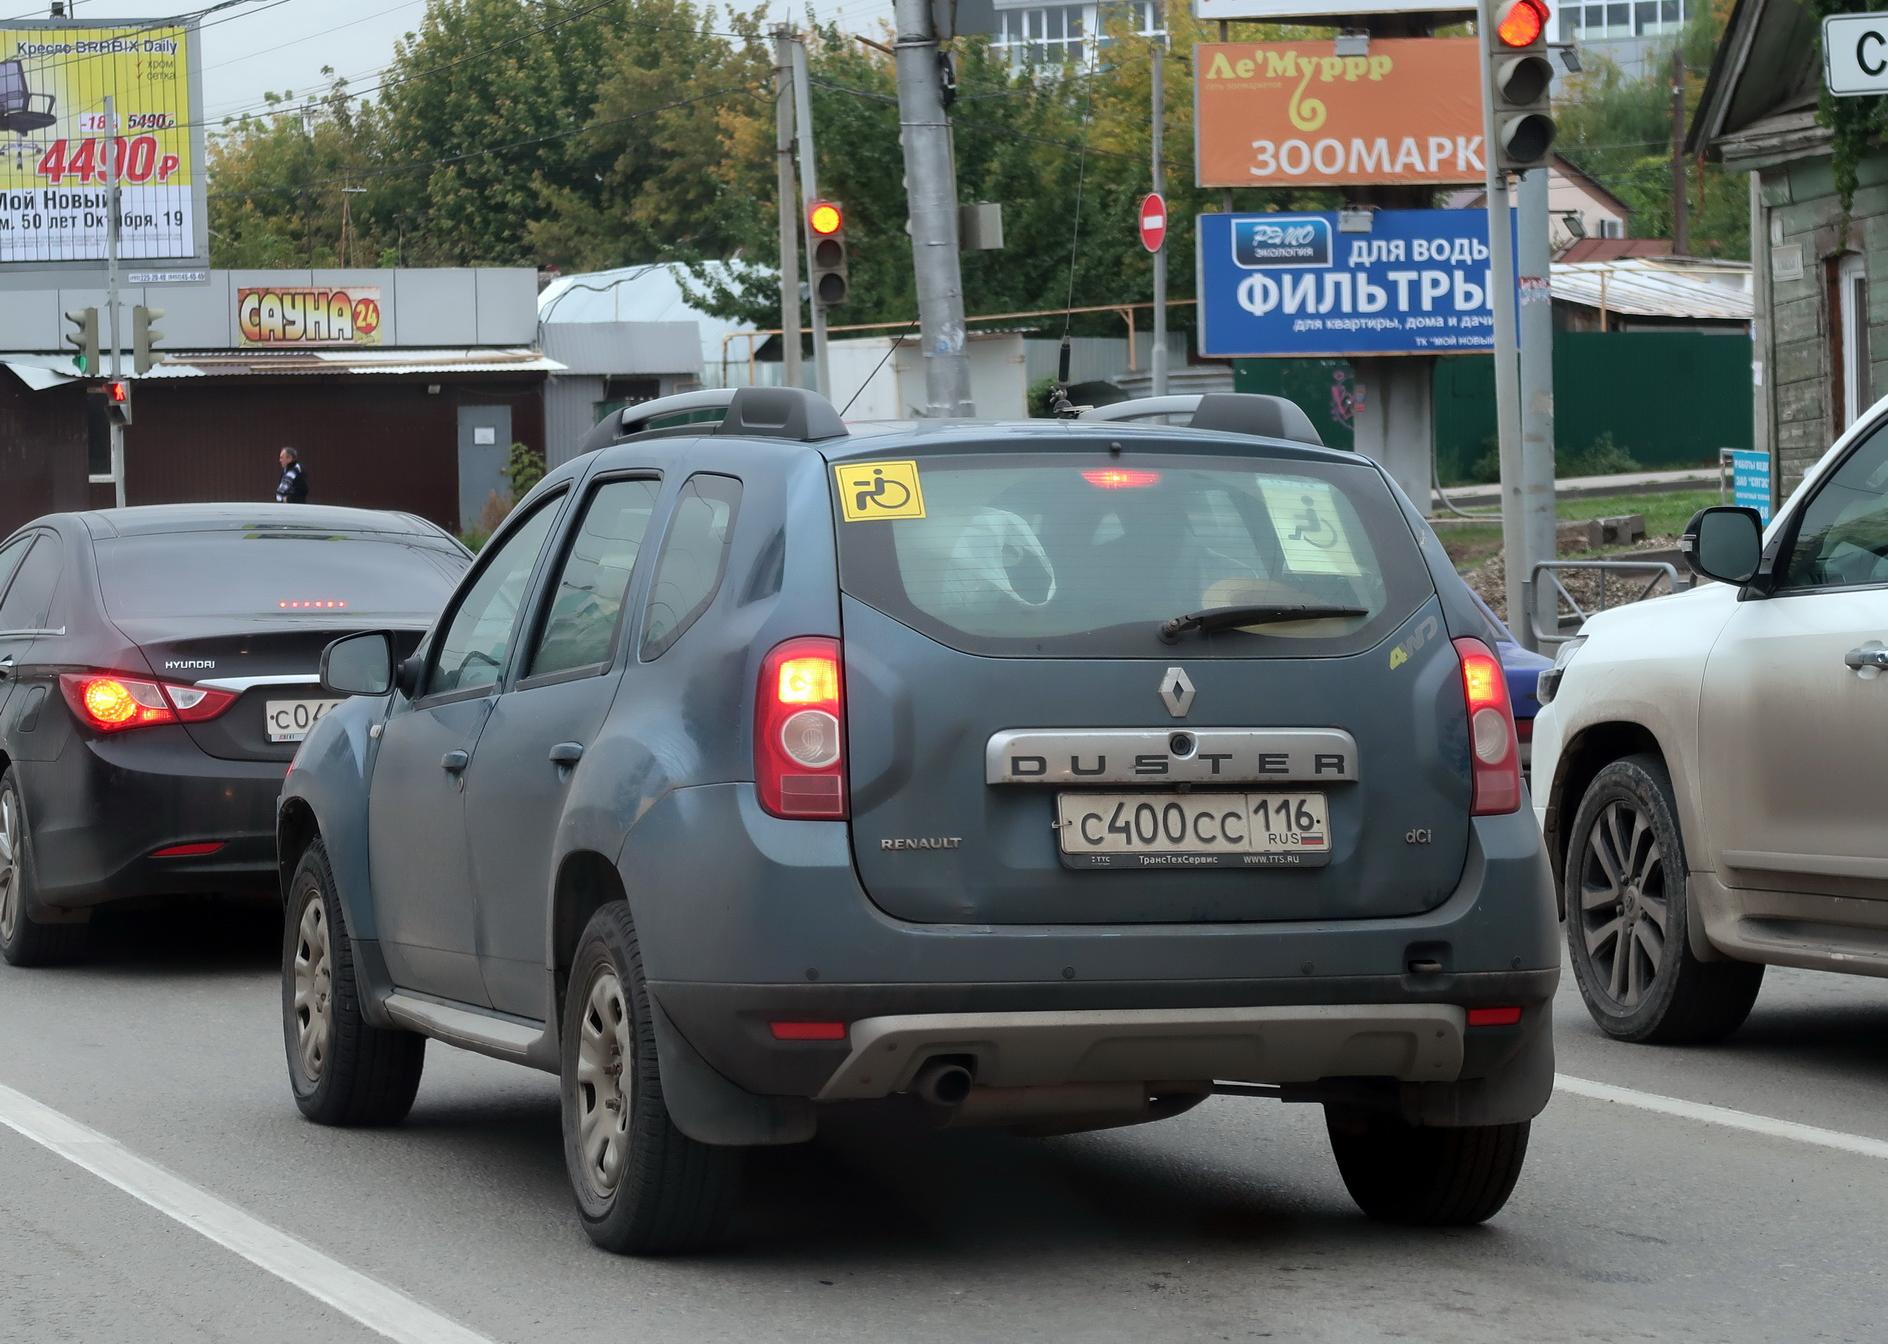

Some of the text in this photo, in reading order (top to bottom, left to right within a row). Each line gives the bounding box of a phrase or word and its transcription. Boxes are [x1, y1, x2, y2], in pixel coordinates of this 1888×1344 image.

[17, 42, 71, 56] Кресло
[144, 39, 177, 55] Daily
[21, 213, 42, 229] 50
[49, 216, 77, 229] лет
[163, 211, 183, 227] 19
[1254, 246, 1314, 258] ЭКОЛОГИЯ
[1348, 239, 1405, 267] ДЛЯ
[1237, 269, 1494, 317] ФИЛЬТРЫ
[239, 291, 378, 341] САУНА 24
[1293, 318, 1322, 332] для
[1405, 315, 1445, 330] дома
[1447, 315, 1458, 327] и
[165, 660, 216, 669] HYUNDAI
[1011, 753, 1345, 776] DUSTER
[1253, 799, 1315, 832] 116
[881, 838, 962, 850] RENAULT
[1268, 832, 1299, 845] RUS
[1138, 855, 1219, 865] ТрансТехСервис
[1243, 855, 1301, 864] WWW.TTS.RU
